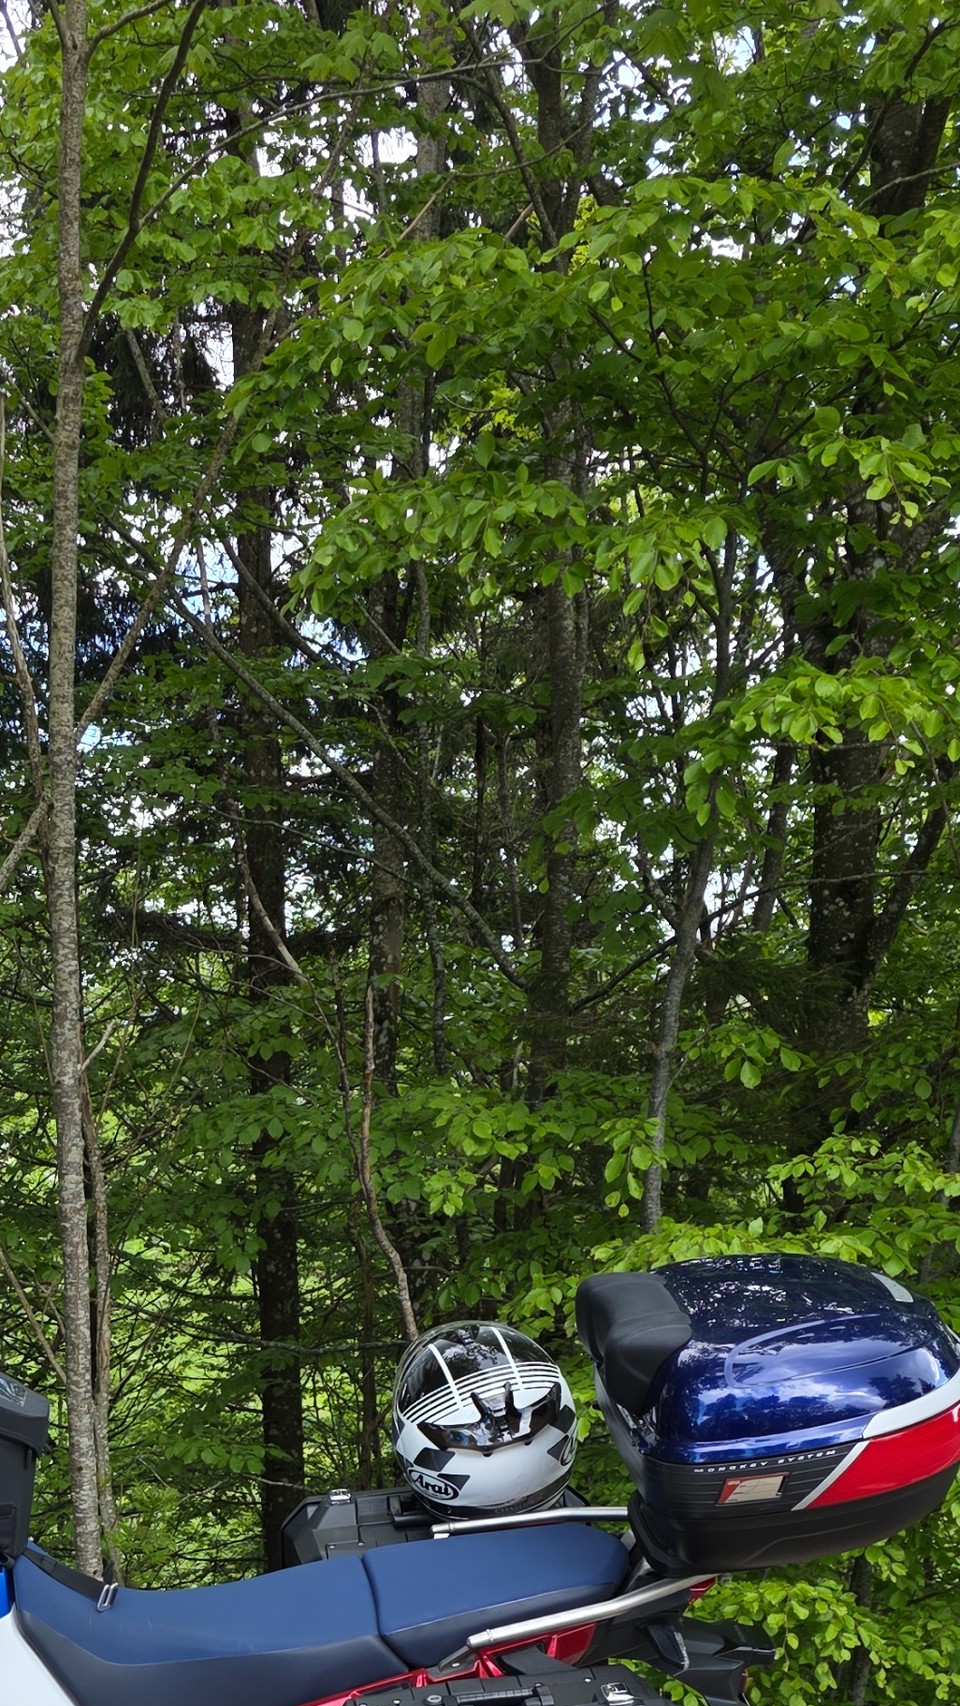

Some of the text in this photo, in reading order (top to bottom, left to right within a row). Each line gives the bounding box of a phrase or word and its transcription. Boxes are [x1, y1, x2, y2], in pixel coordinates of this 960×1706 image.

[694, 1450, 836, 1473] MONOKEY SYSTEM
[414, 1474, 451, 1496] Arai
